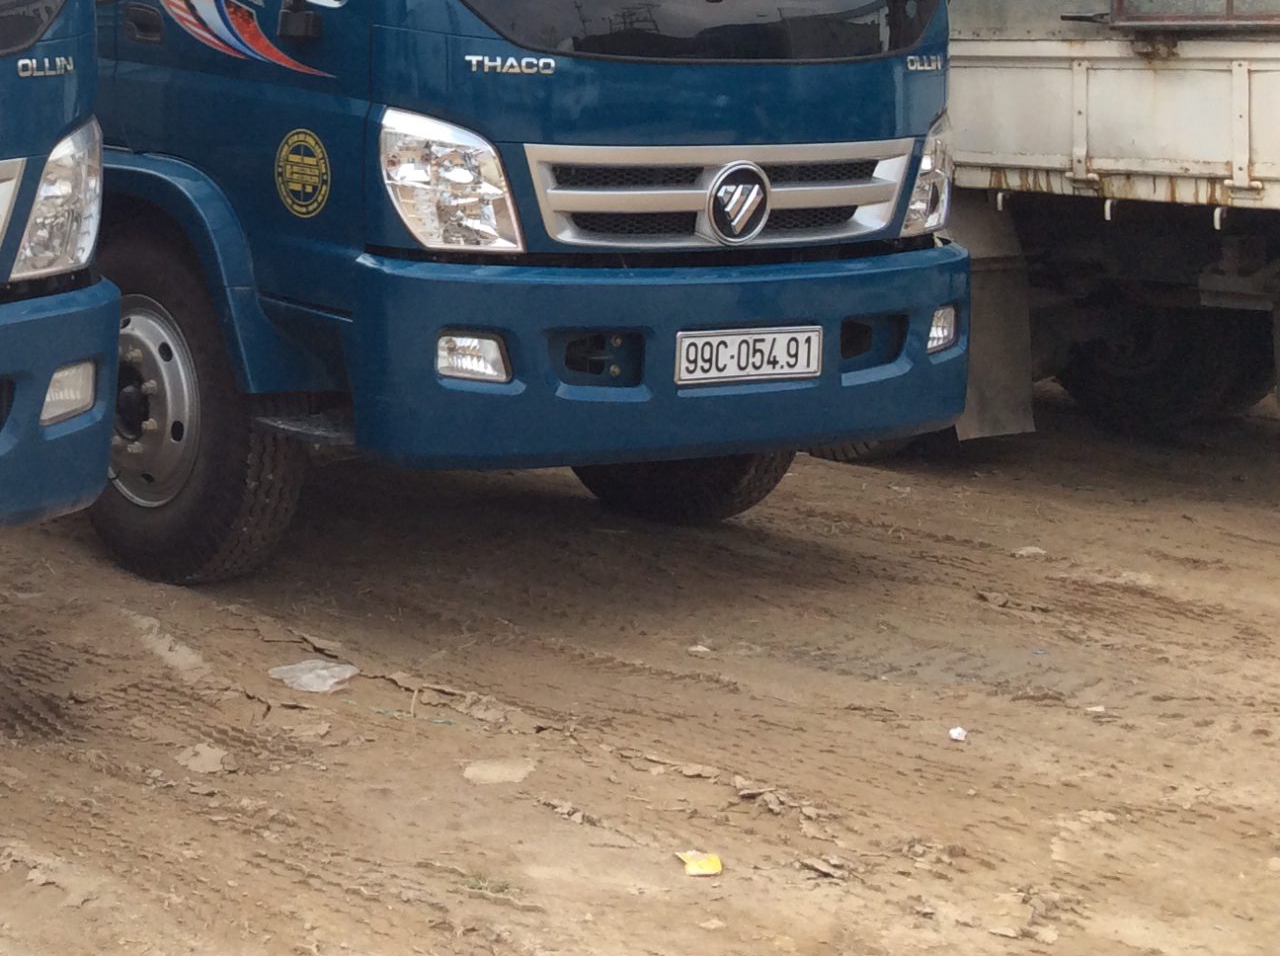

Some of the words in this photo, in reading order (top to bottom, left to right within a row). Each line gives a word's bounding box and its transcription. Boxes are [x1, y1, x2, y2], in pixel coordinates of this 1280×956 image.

[17, 56, 74, 77] OLLIN
[464, 55, 556, 74] THACO
[906, 54, 944, 71] OLLIN
[685, 335, 812, 374] 99C-054.91
